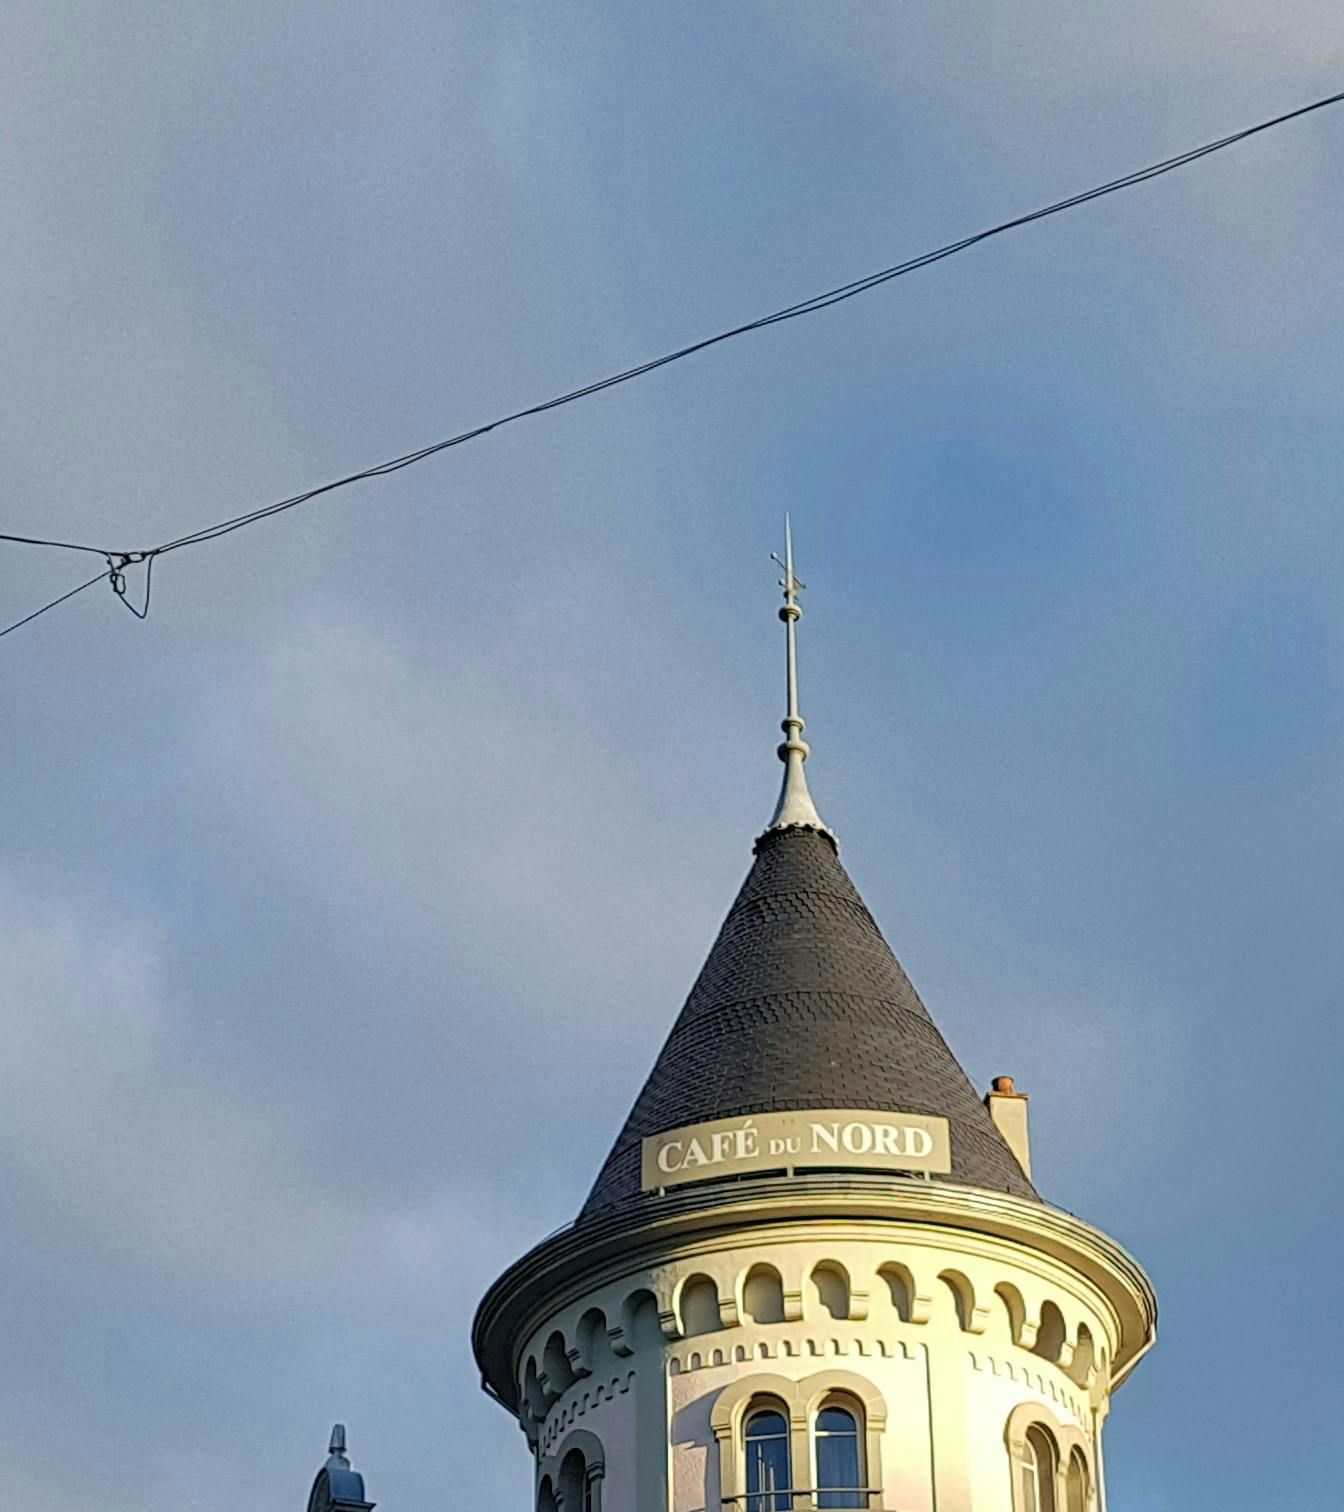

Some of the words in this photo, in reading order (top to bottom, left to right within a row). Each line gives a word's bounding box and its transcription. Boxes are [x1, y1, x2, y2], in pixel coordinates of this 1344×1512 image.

[657, 1119, 760, 1173] CAFÉ
[769, 1137, 801, 1155] DU
[810, 1122, 933, 1157] NORD
